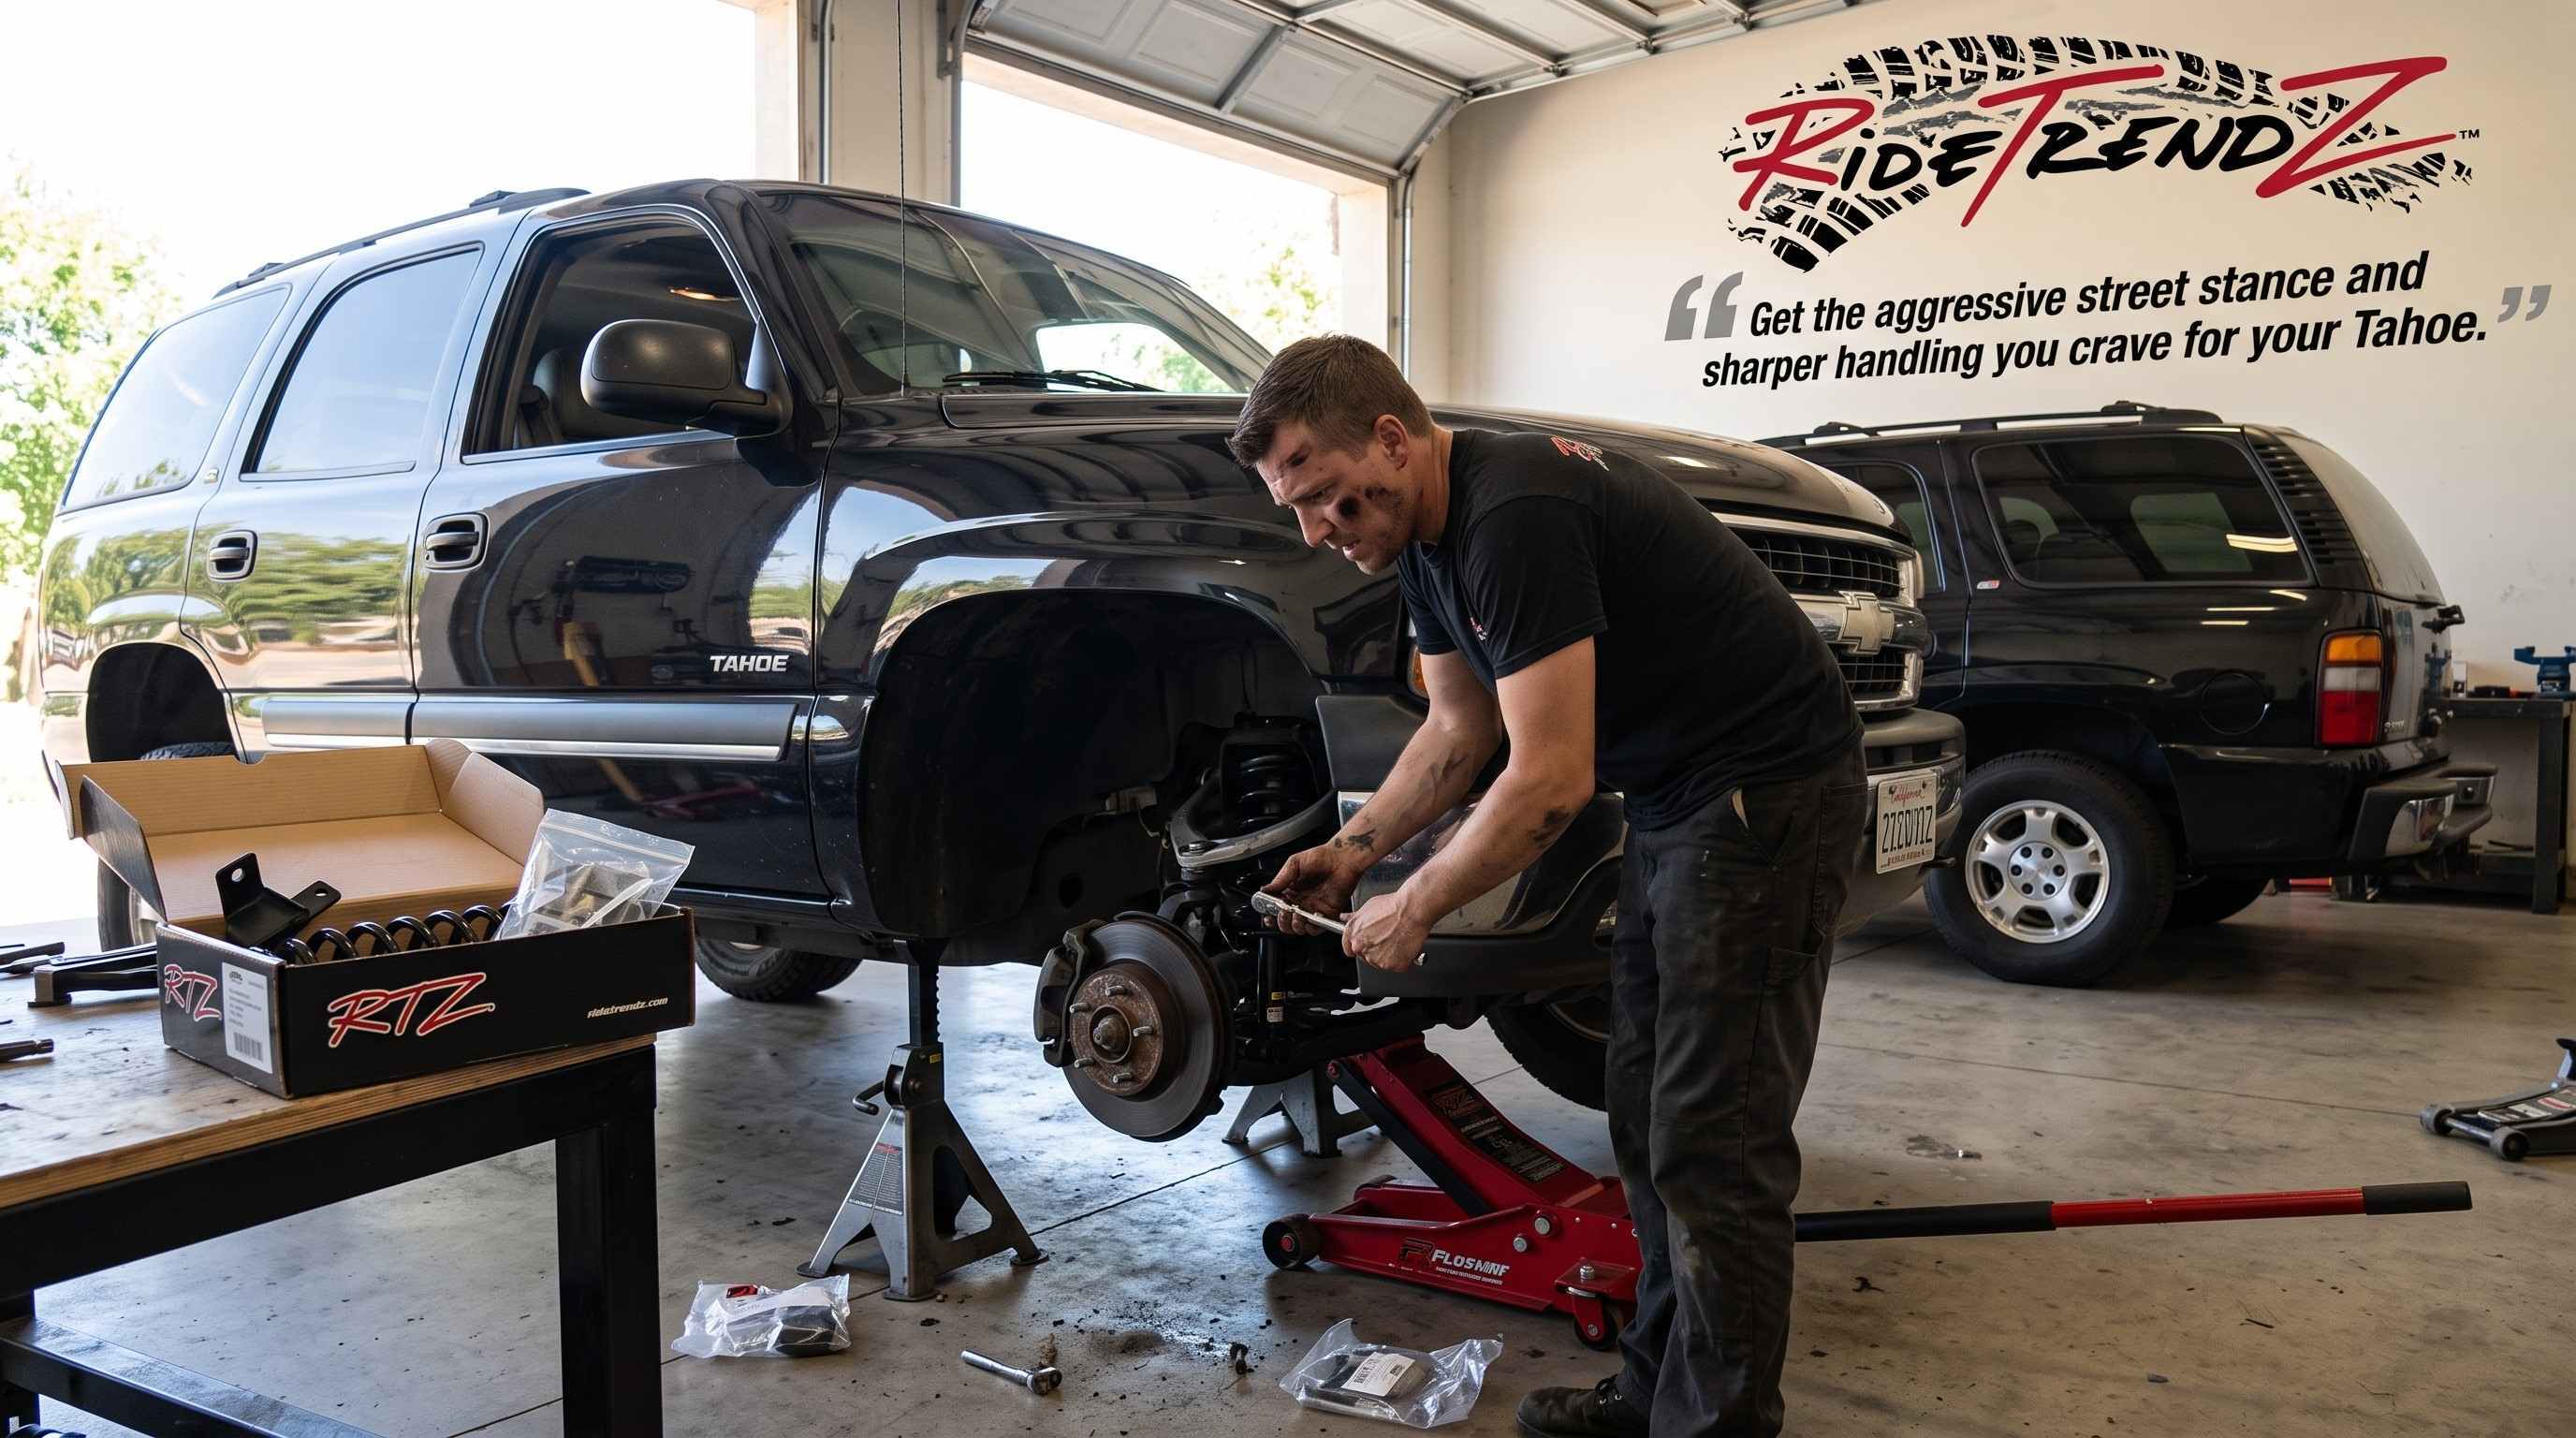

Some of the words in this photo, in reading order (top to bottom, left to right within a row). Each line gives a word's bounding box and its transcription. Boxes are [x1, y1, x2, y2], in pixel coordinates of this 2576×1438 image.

[1750, 301, 1806, 337] Get
[1813, 297, 1866, 332] the
[1874, 281, 2067, 334] aggressive
[2076, 271, 2190, 315] street
[2198, 266, 2334, 307] stance
[2346, 249, 2430, 295] and
[1702, 352, 1828, 390] sharper
[1835, 338, 1984, 380] handling
[1991, 339, 2060, 378] you
[2069, 331, 2173, 366] crave
[2184, 320, 2241, 359] for
[2246, 319, 2343, 363] your
[2354, 306, 2487, 348] Tahoe.
[710, 654, 790, 673] TAHOE
[164, 963, 223, 1022] RTZ
[327, 972, 496, 1049] RTZ
